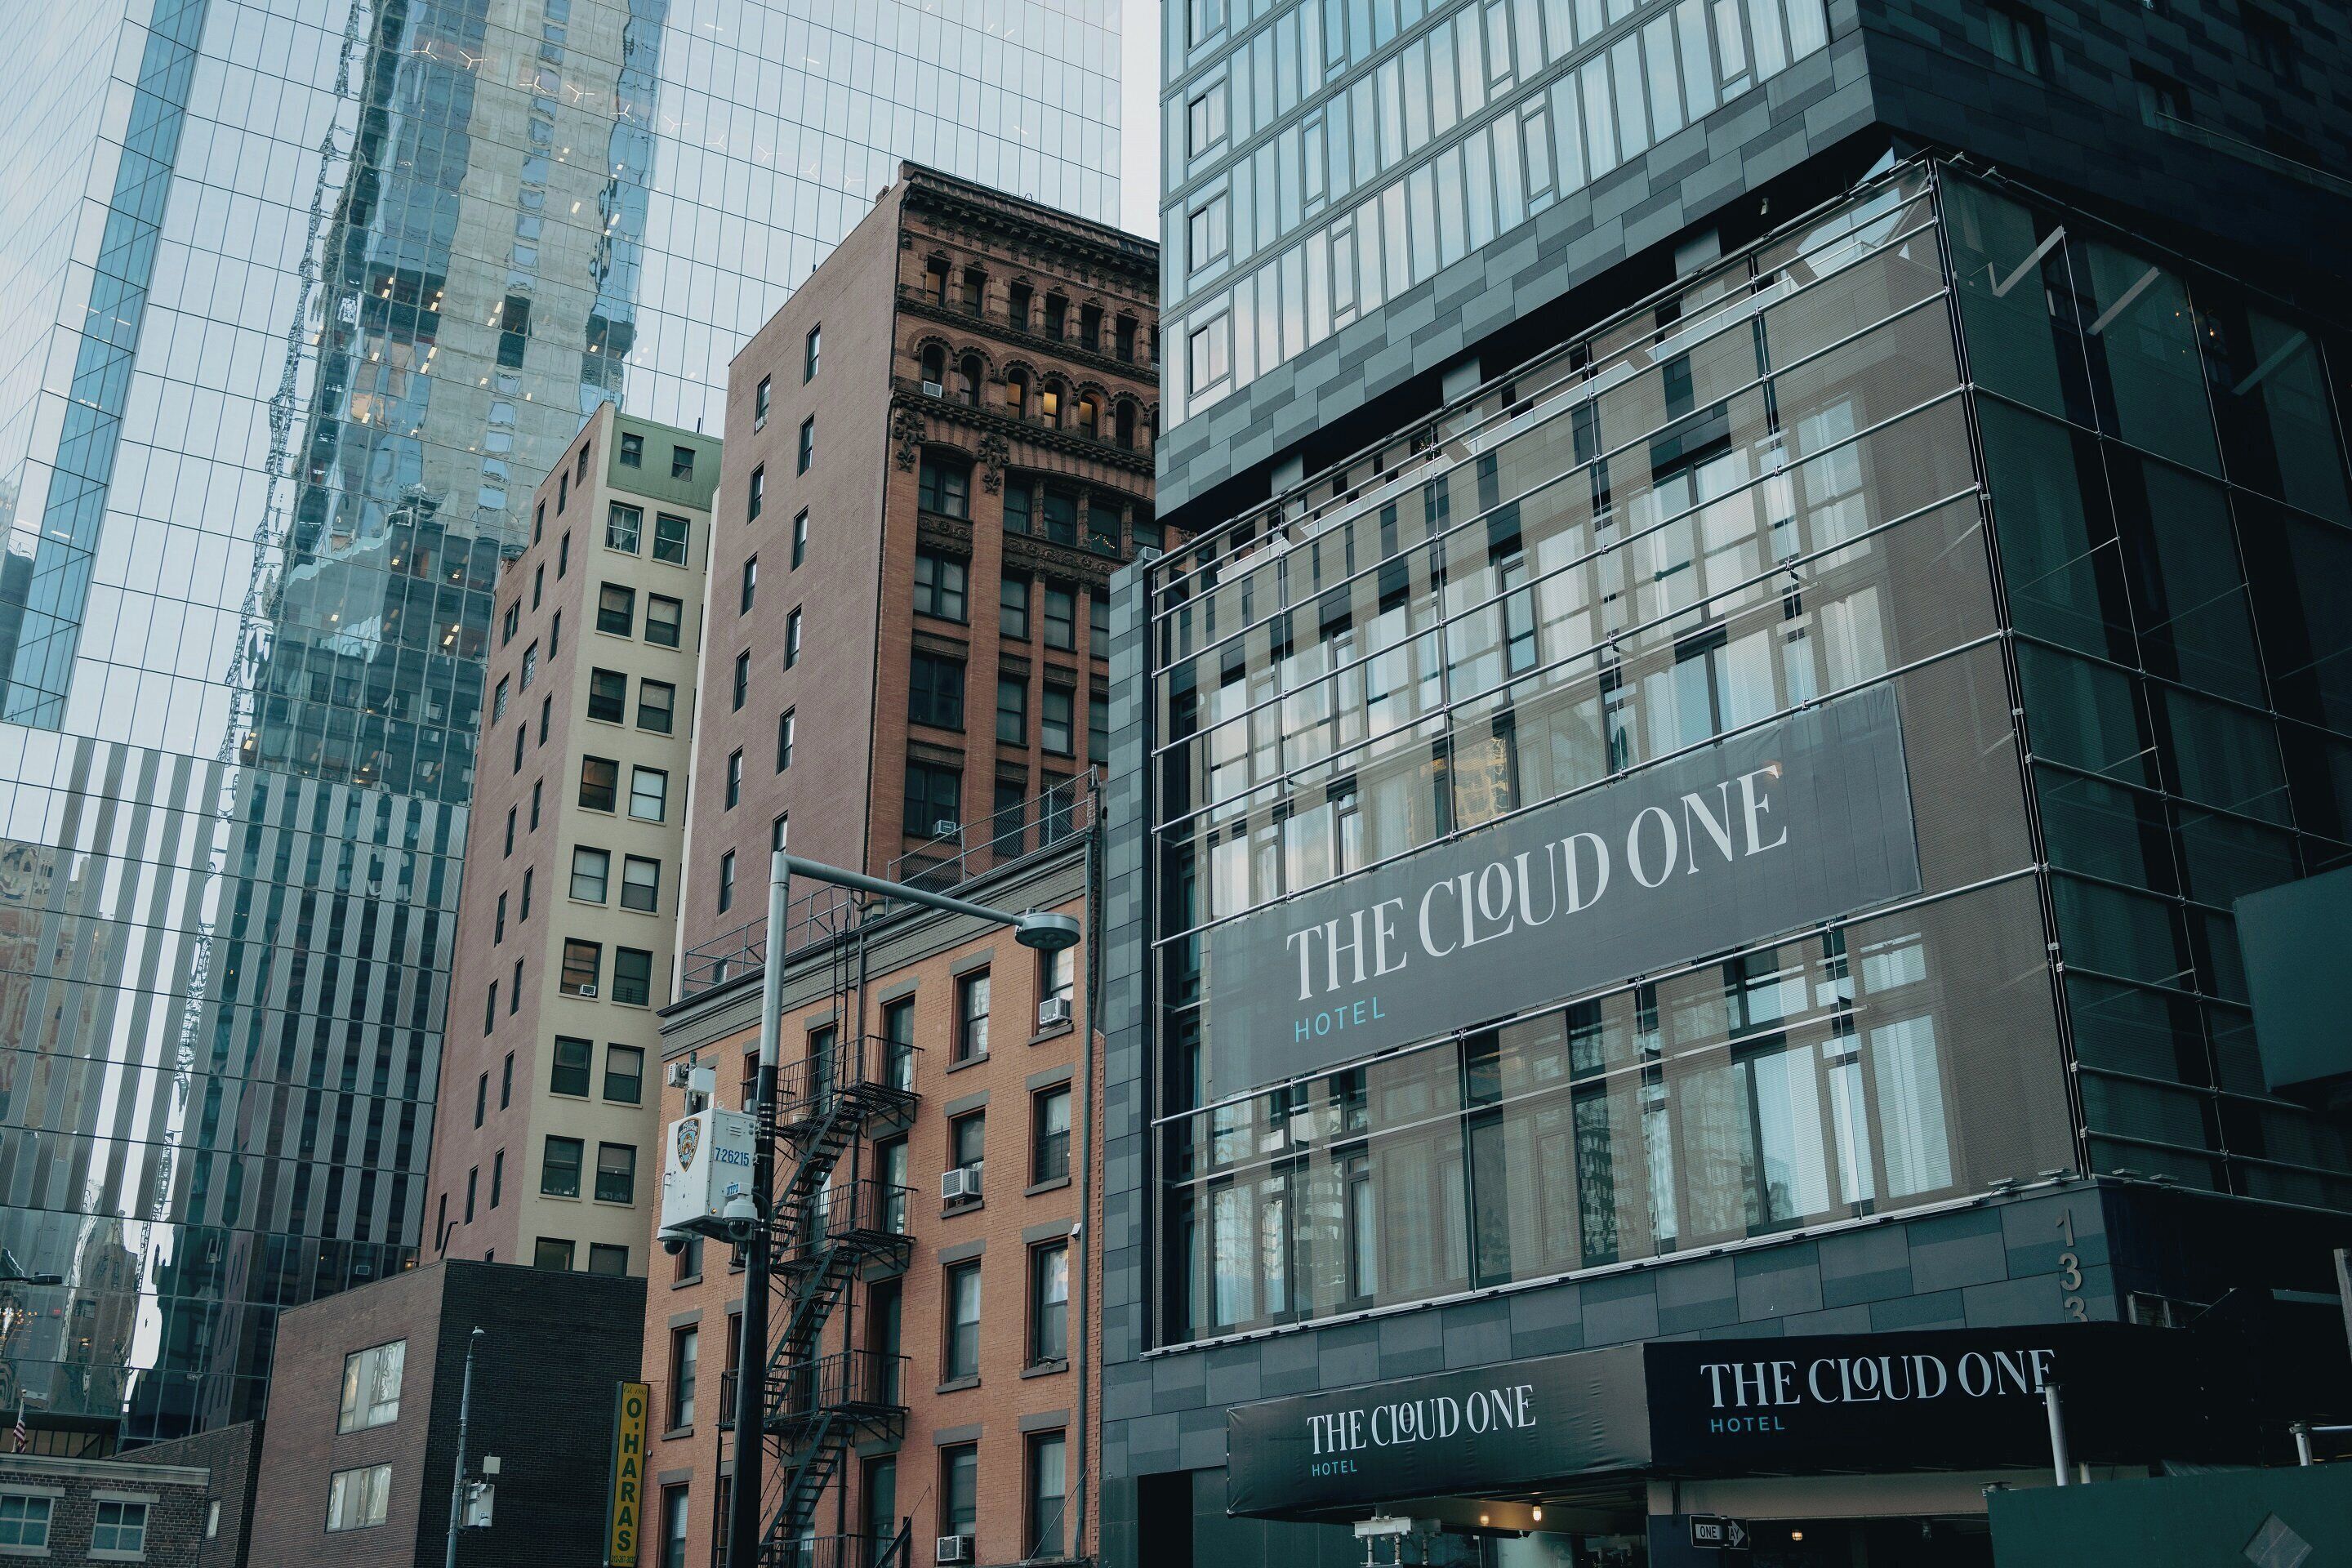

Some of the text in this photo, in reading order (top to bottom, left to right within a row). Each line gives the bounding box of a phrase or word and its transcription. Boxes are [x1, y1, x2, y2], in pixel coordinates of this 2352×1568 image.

[1286, 764, 1788, 1001] THE CLOUD ONE
[1294, 996, 1386, 1043] HOTEL
[1700, 1349, 2056, 1408] THE CLOUD ONE
[1307, 1384, 1536, 1454] THE CLOUD ONE
[1710, 1415, 1785, 1433] HOTEL
[617, 1397, 643, 1552] O'HARAS
[1312, 1459, 1357, 1477] HOTEL
[1699, 1526, 1740, 1540] ONE AY
